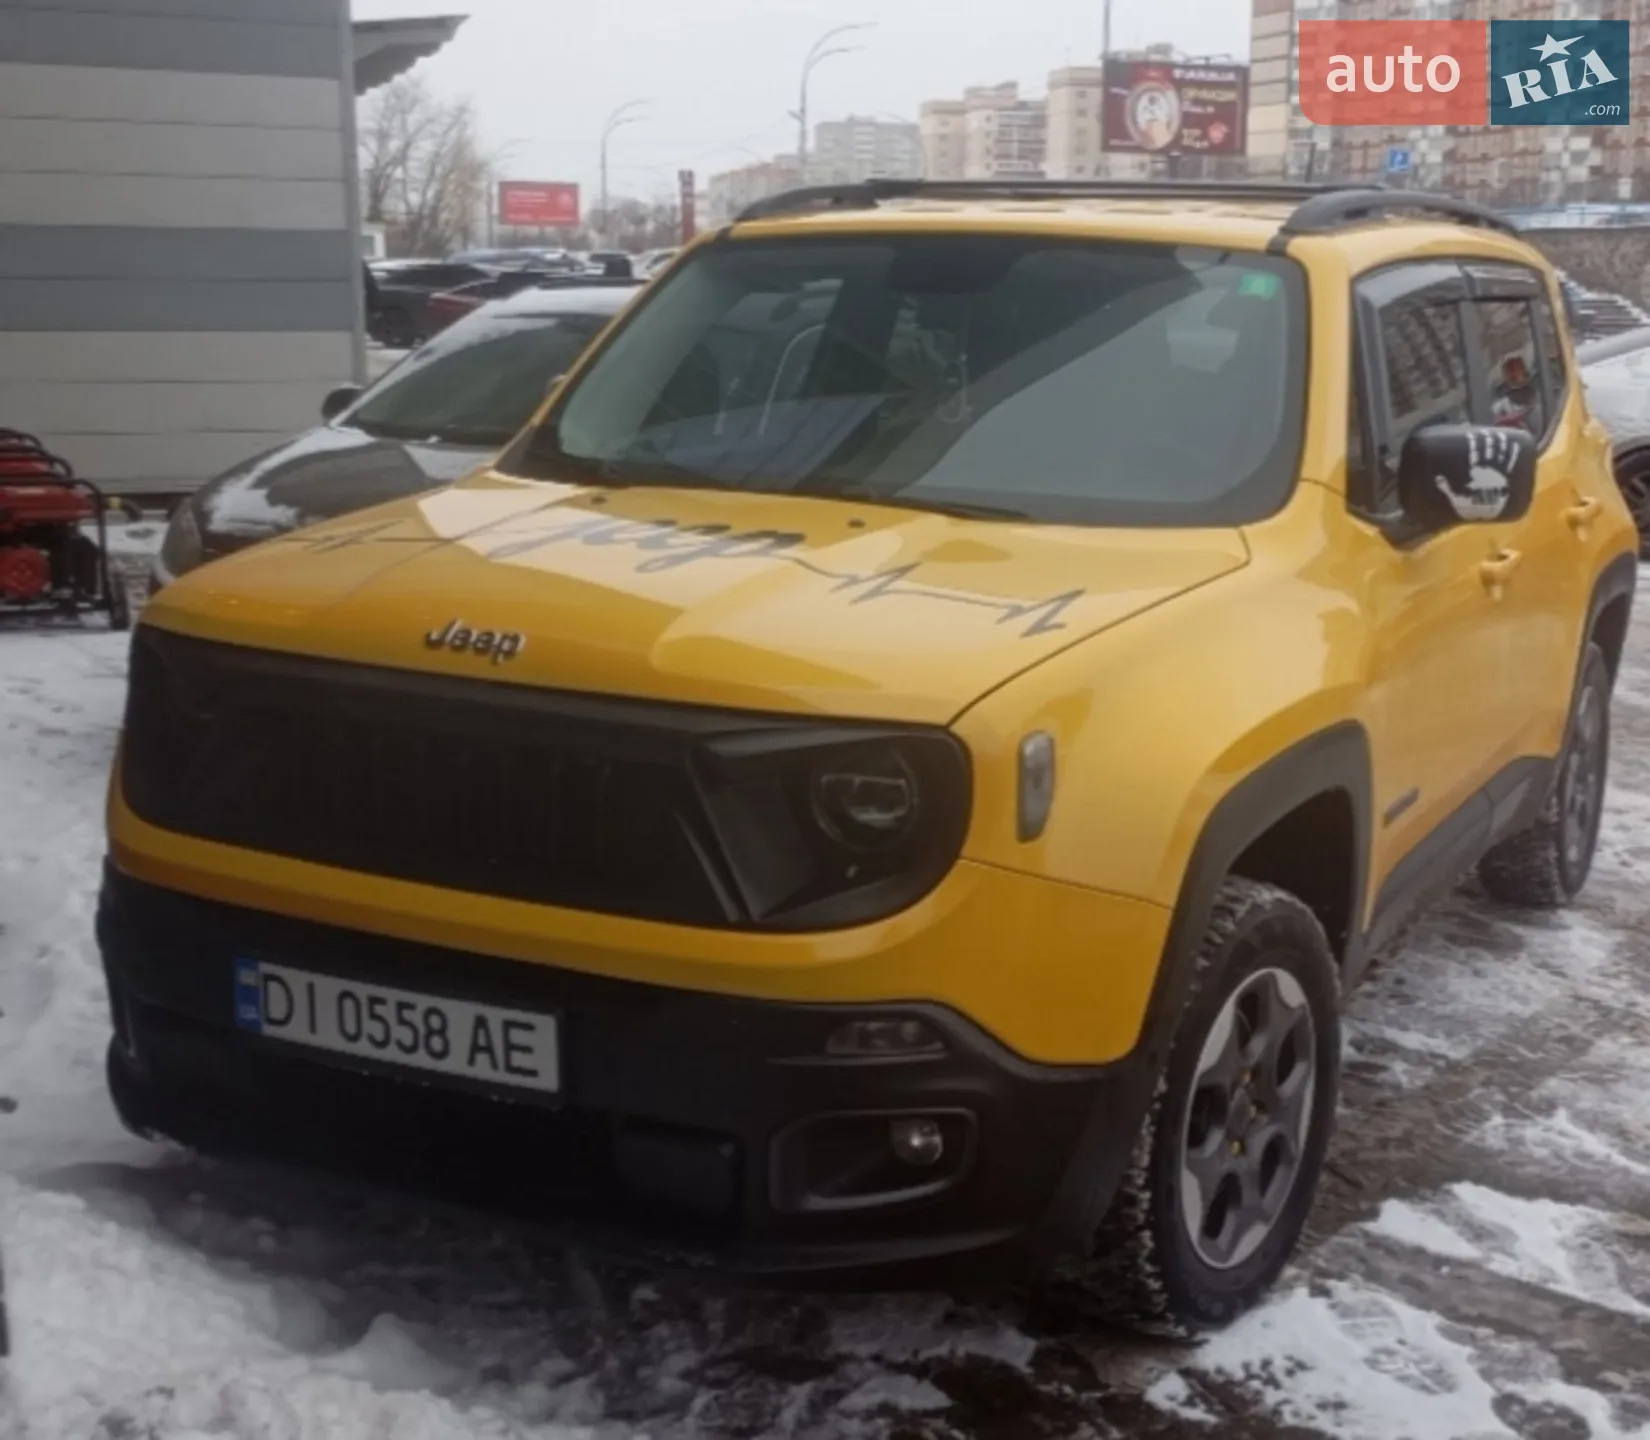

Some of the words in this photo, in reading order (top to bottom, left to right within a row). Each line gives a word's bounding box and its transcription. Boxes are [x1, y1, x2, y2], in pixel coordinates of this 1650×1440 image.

[424, 617, 527, 666] Jeep
[261, 972, 318, 1035] DI
[336, 989, 452, 1062] 0558
[466, 1013, 540, 1078] AE
